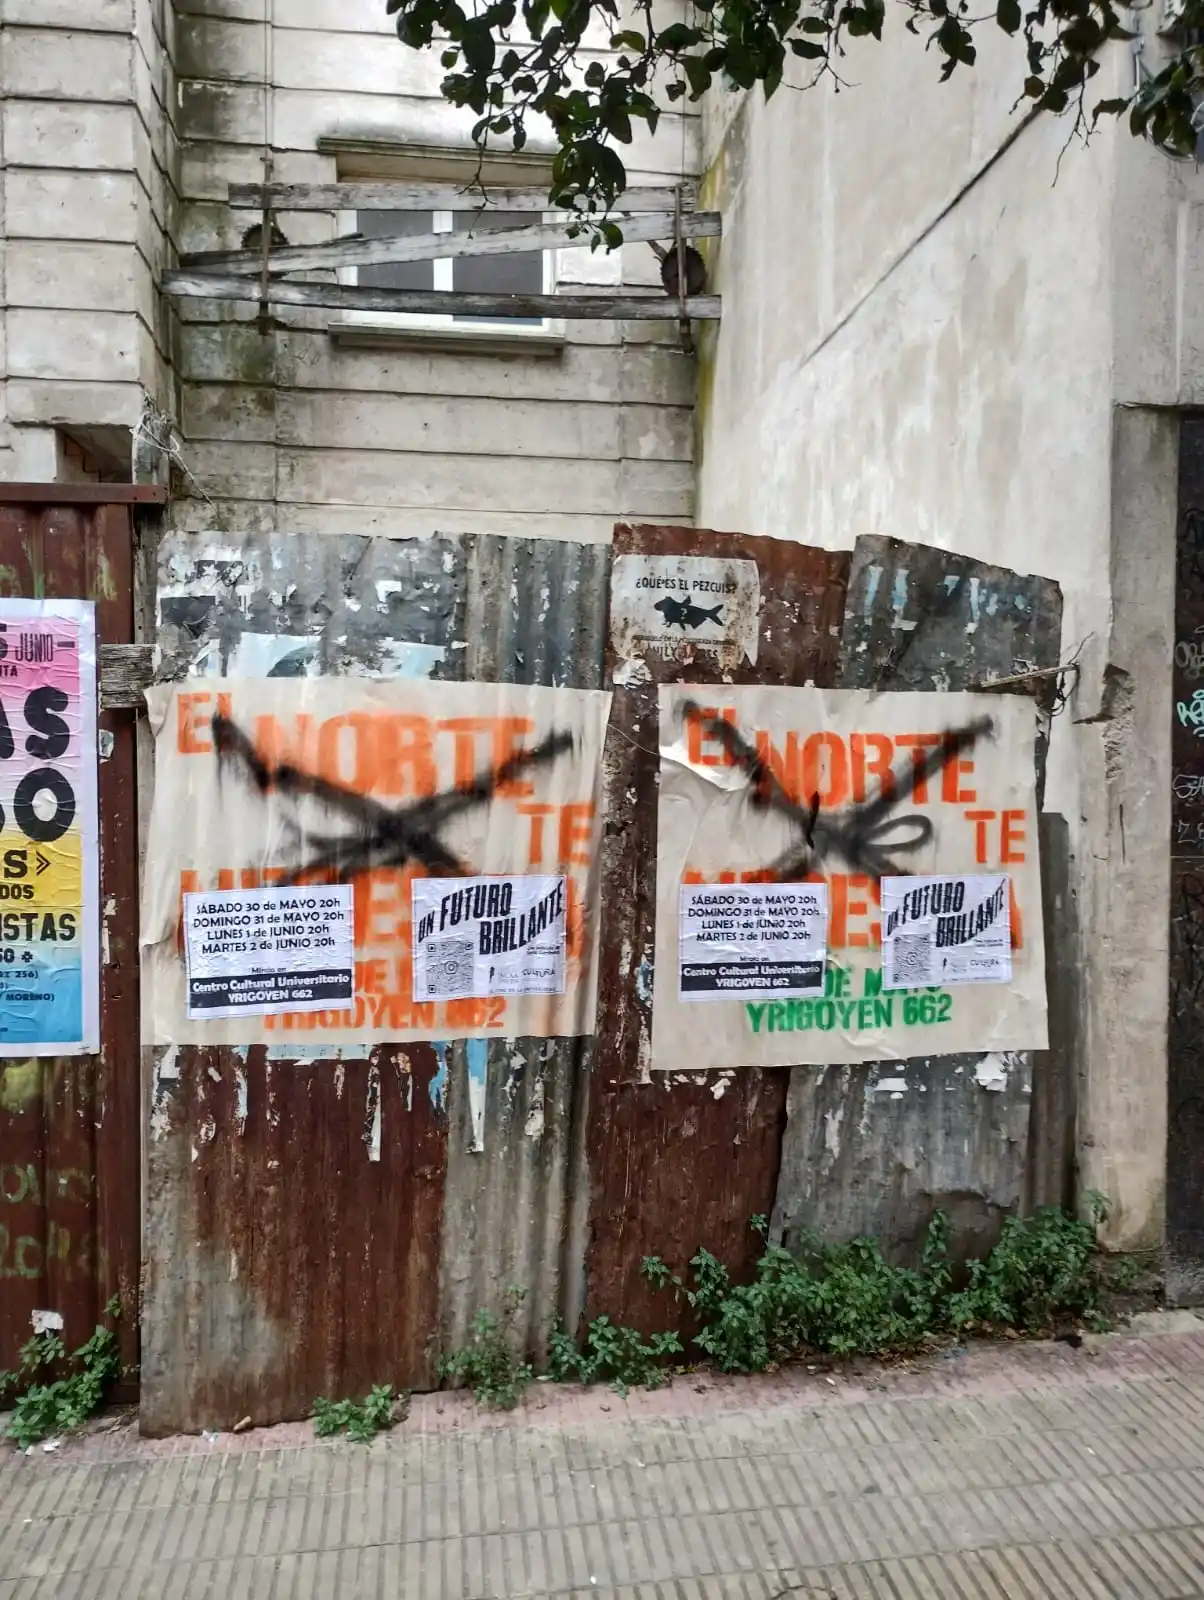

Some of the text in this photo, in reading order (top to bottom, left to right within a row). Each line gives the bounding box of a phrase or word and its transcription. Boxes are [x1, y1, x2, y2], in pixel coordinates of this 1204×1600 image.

[679, 579, 689, 590] EL
[15, 633, 53, 662] JUNIO
[0, 665, 18, 676] TA
[0, 686, 70, 759] S
[756, 731, 976, 806] NORTE
[0, 767, 76, 842] O
[516, 803, 595, 866] TE
[964, 810, 1025, 864] TE
[197, 898, 341, 914] SÁBADO 30 de MAYO 20h
[691, 894, 817, 905] SÁBADO 30 de MAYO 20h
[902, 881, 965, 925] FUTURO
[193, 911, 344, 928] DOMINGO 31 de MAYO 20h
[418, 910, 435, 943] UN
[440, 882, 512, 932] FUTURO
[479, 879, 563, 955] BRILLANTE
[688, 907, 820, 917] DOMINGO 31 de MAYO 20h
[936, 878, 1006, 948] BRILLANTE
[0, 913, 76, 941] STAS
[207, 925, 329, 940] LUNES 1 de JUNIO 20h
[702, 919, 806, 929] LUNES 1 de JUNIO 20h
[696, 931, 811, 941] MARTES 2 de JUNIO 20h
[202, 937, 335, 954] MARTES 2 de JUNIO 20h
[683, 968, 717, 976] Centro
[718, 966, 759, 975] Cultural
[193, 974, 350, 992] Centro Cultural Universitario
[716, 978, 771, 988] YRIGOYEN
[228, 990, 313, 1003] YRIGOYEN 662
[746, 994, 953, 1032] YRIGOYEN 662
